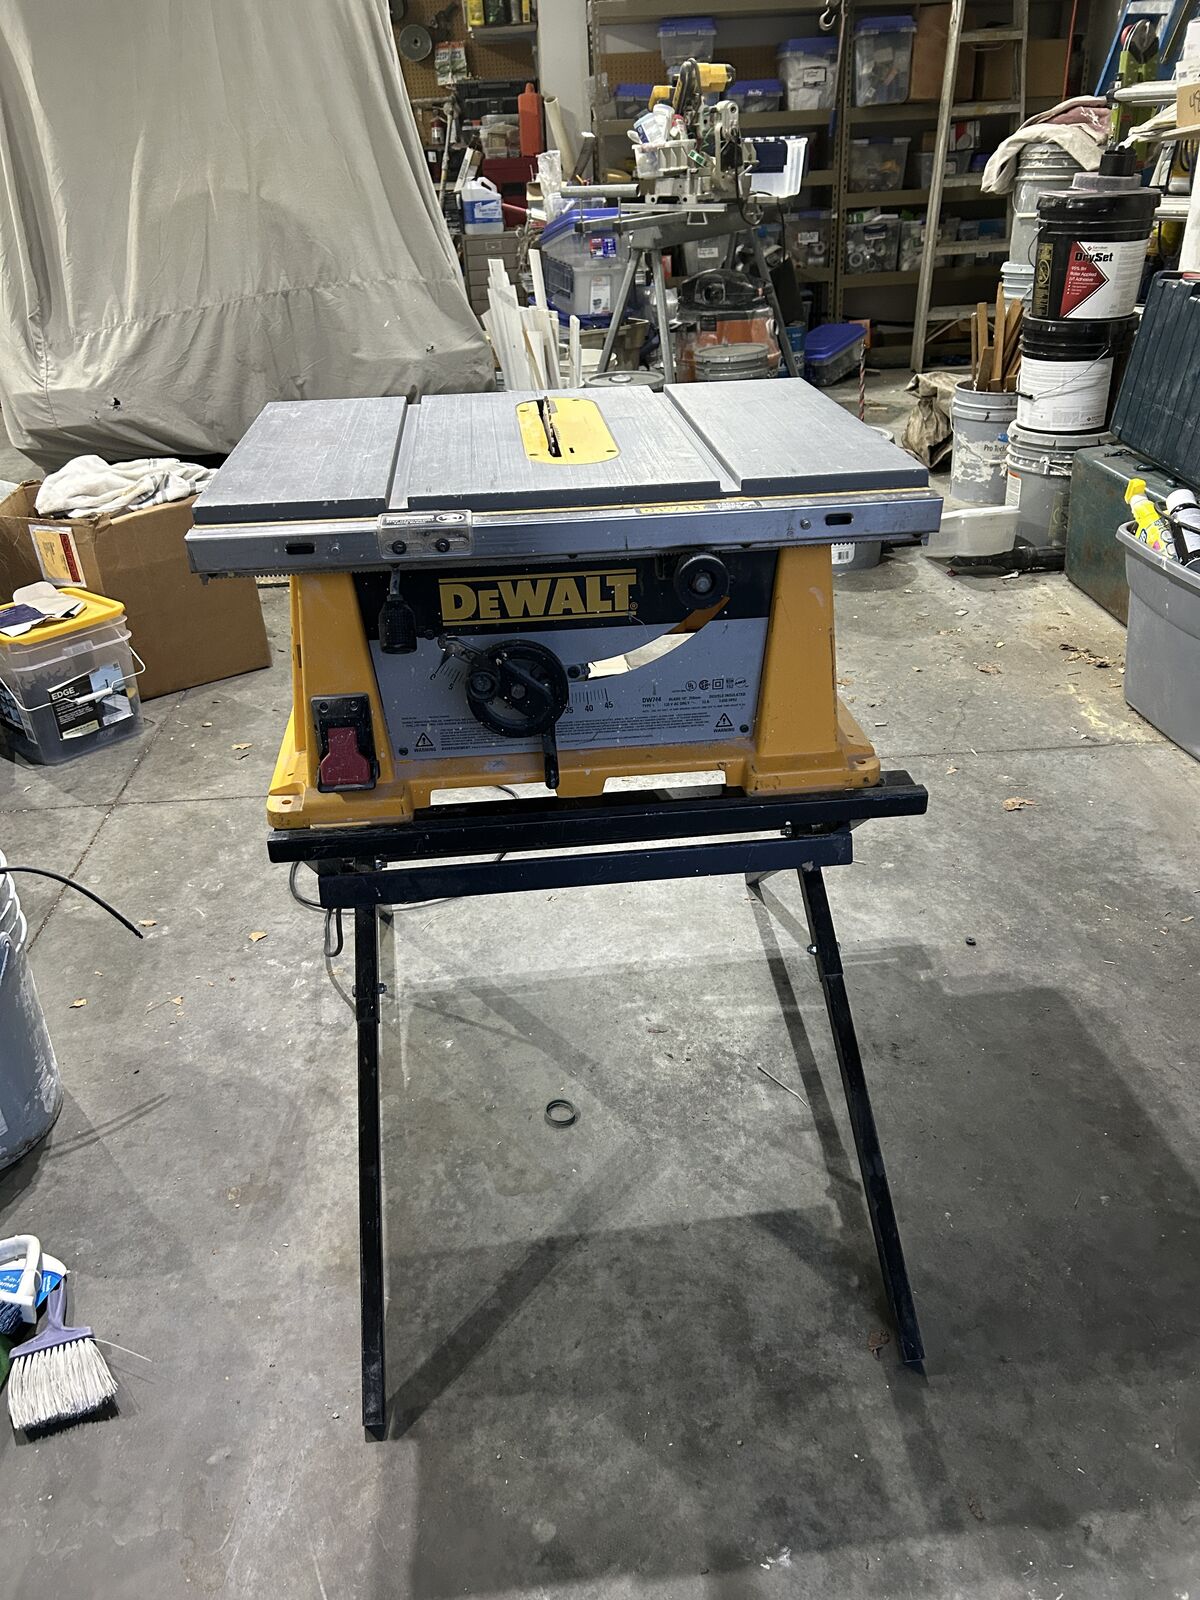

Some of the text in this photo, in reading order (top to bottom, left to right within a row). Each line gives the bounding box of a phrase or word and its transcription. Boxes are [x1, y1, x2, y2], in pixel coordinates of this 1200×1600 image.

[1075, 252, 1114, 264] DrySet
[983, 443, 993, 452] Pro
[438, 574, 637, 621] DEWALT
[51, 687, 75, 700] EDGE
[585, 704, 594, 712] 40
[604, 701, 614, 709] 45
